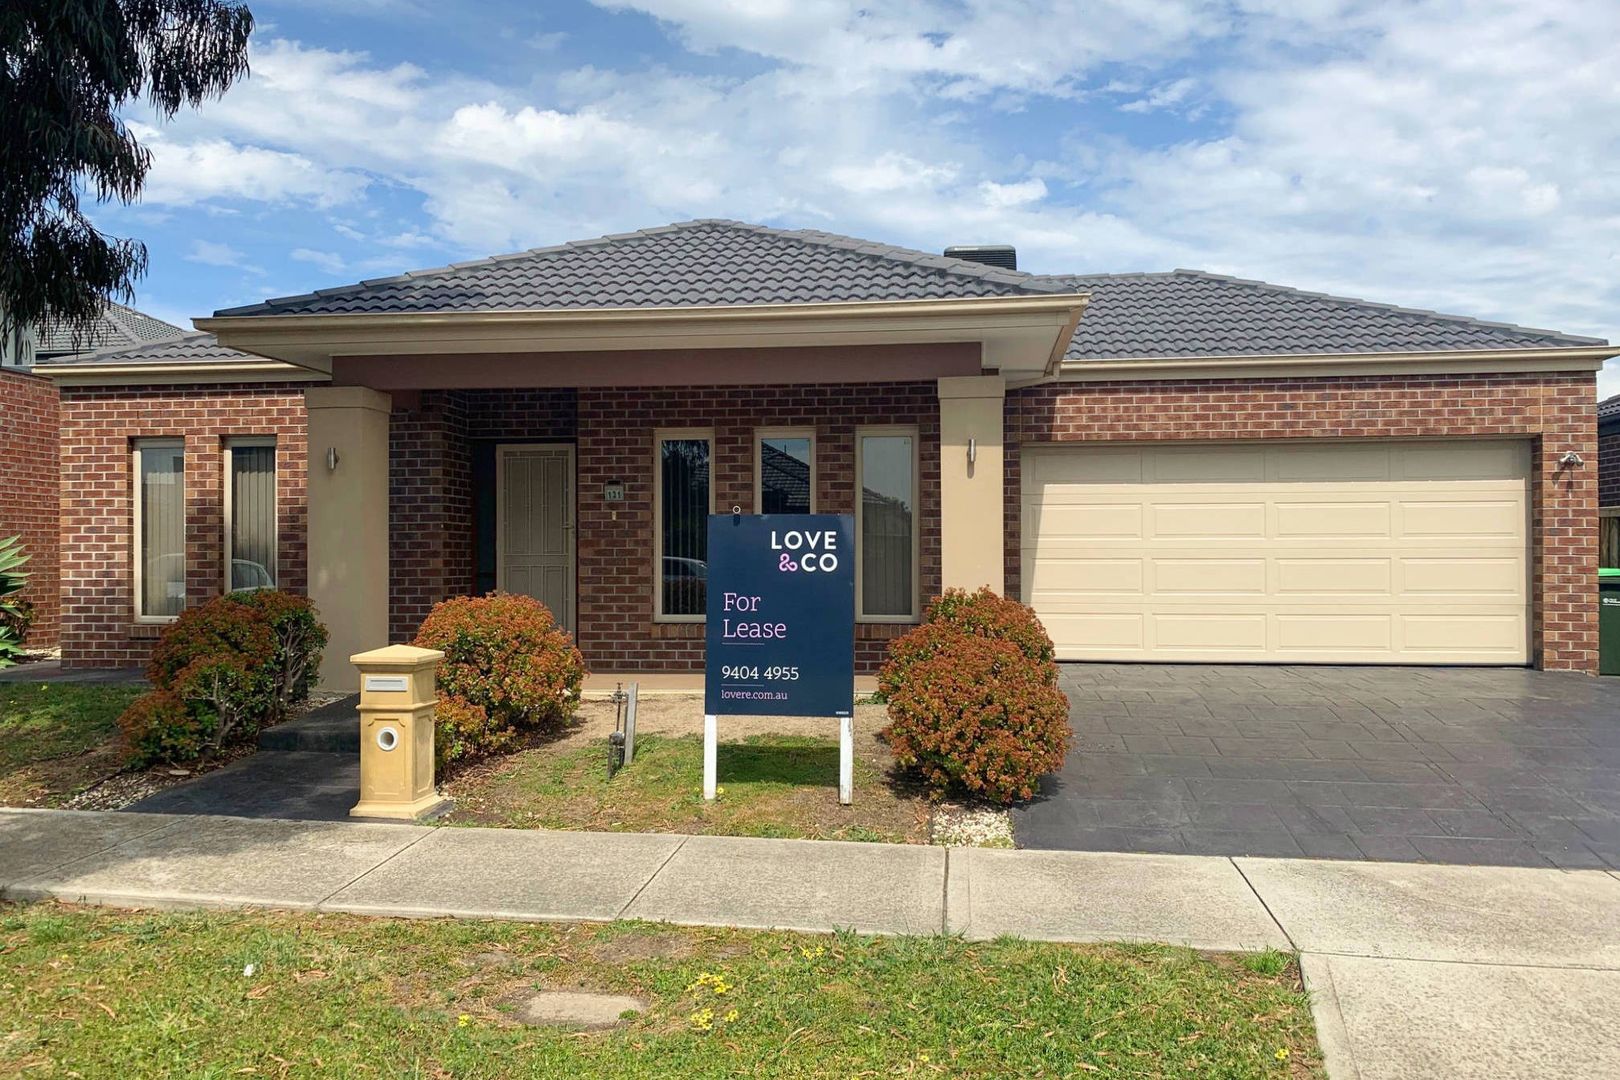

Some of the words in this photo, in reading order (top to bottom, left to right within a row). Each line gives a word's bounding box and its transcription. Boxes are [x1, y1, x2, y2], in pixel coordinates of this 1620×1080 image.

[771, 530, 837, 550] LOVE
[779, 553, 838, 572] &CO
[723, 592, 761, 612] For
[723, 619, 787, 639] Lease
[721, 665, 759, 680] 9404
[764, 666, 799, 681] 4955
[721, 689, 788, 700] lovere.com.au
